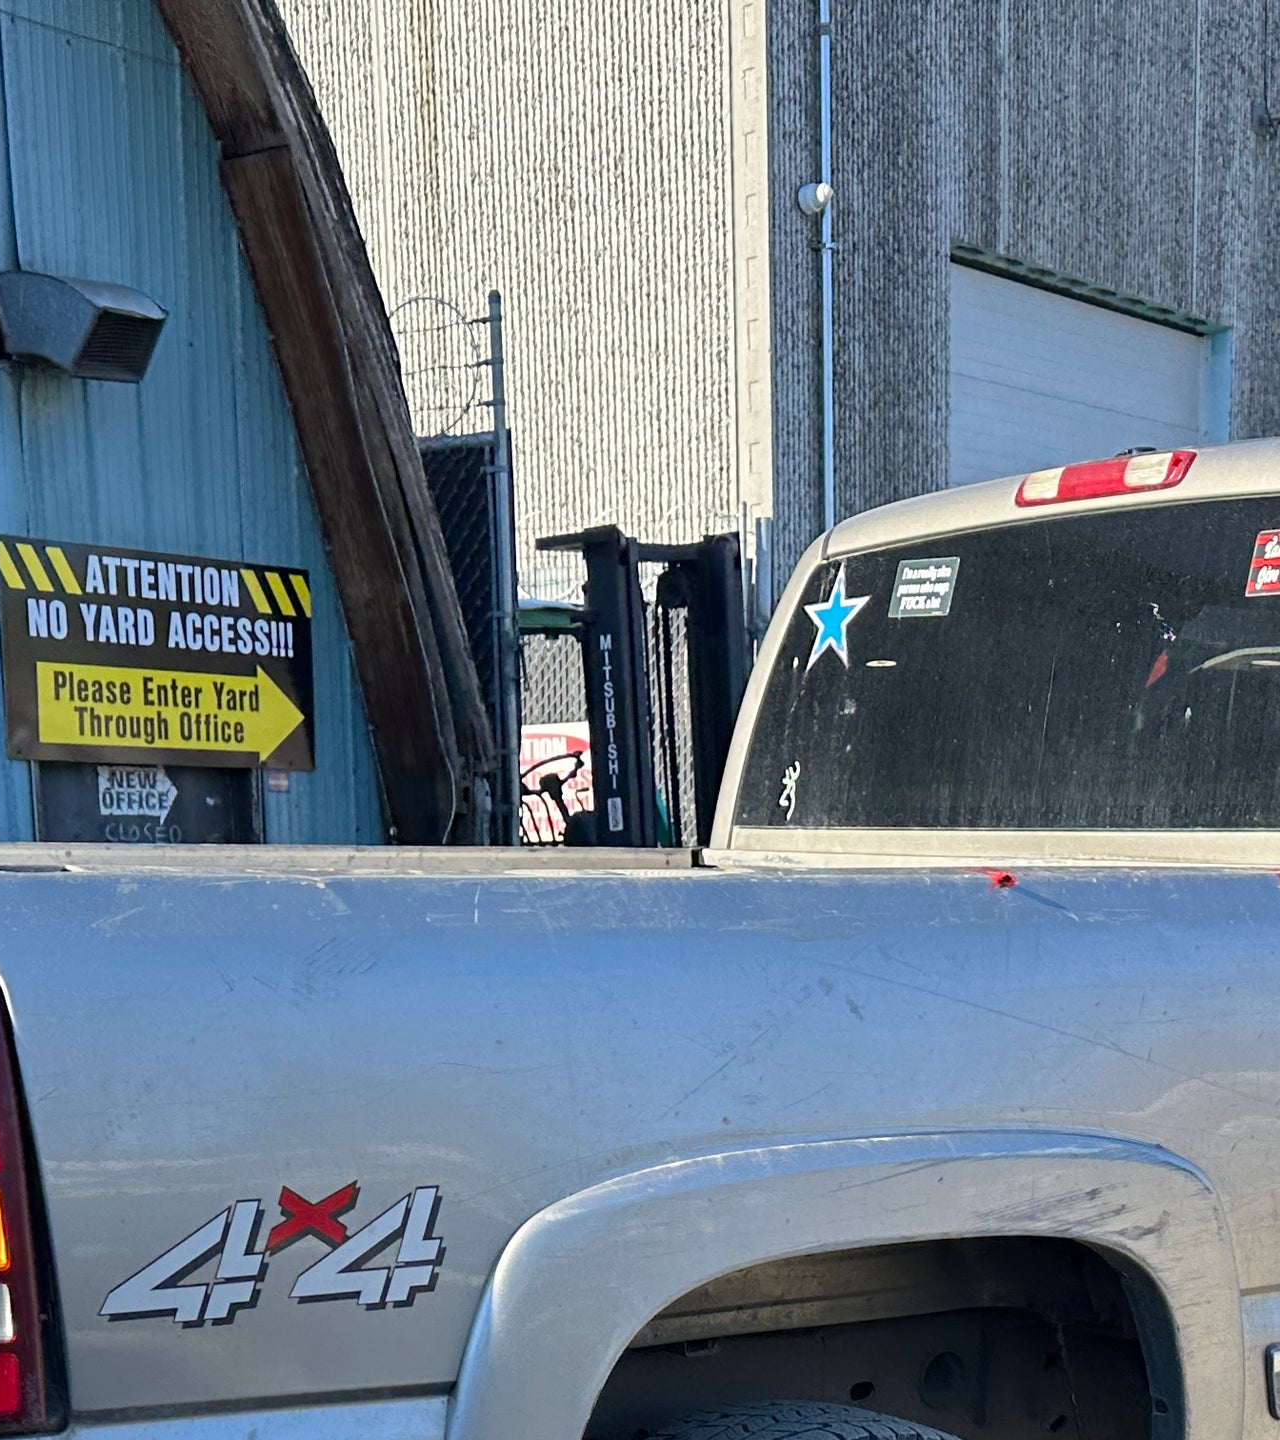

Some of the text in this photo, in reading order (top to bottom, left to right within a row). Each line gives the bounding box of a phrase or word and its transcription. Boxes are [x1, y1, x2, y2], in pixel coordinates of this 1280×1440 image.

[85, 554, 240, 607] ATTENTION
[27, 598, 294, 658] NO YARD ACCESS!!!
[53, 670, 260, 712] Please Enter Yard
[600, 633, 619, 790] MITSUBISHI
[74, 706, 245, 744] Through Office
[102, 787, 170, 810] OFFICE
[107, 768, 158, 789] NEW
